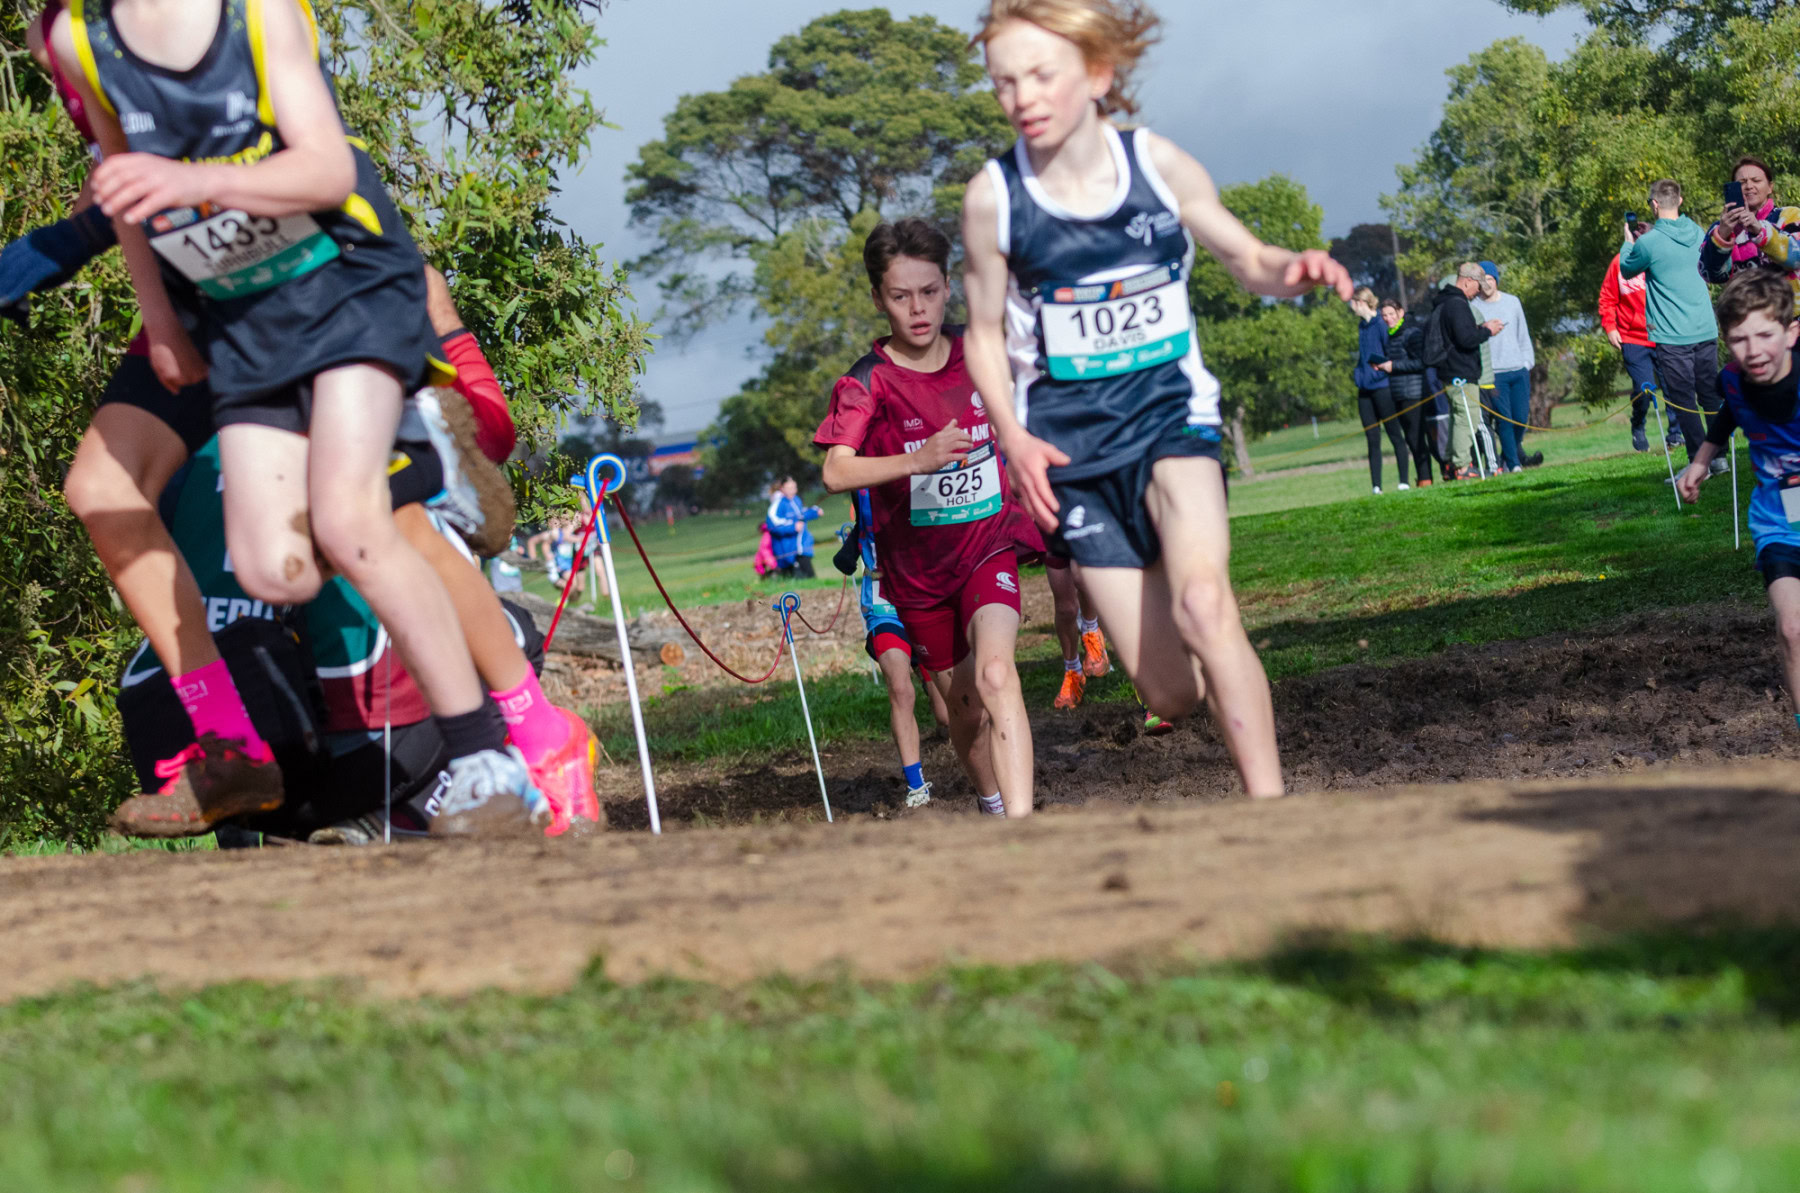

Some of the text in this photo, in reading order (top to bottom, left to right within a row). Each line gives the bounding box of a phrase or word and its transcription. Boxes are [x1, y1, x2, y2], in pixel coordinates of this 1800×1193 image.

[1070, 295, 1164, 338] 1023
[1093, 331, 1147, 351] DAVIS
[938, 466, 983, 497] 625
[946, 492, 977, 506] HOLT
